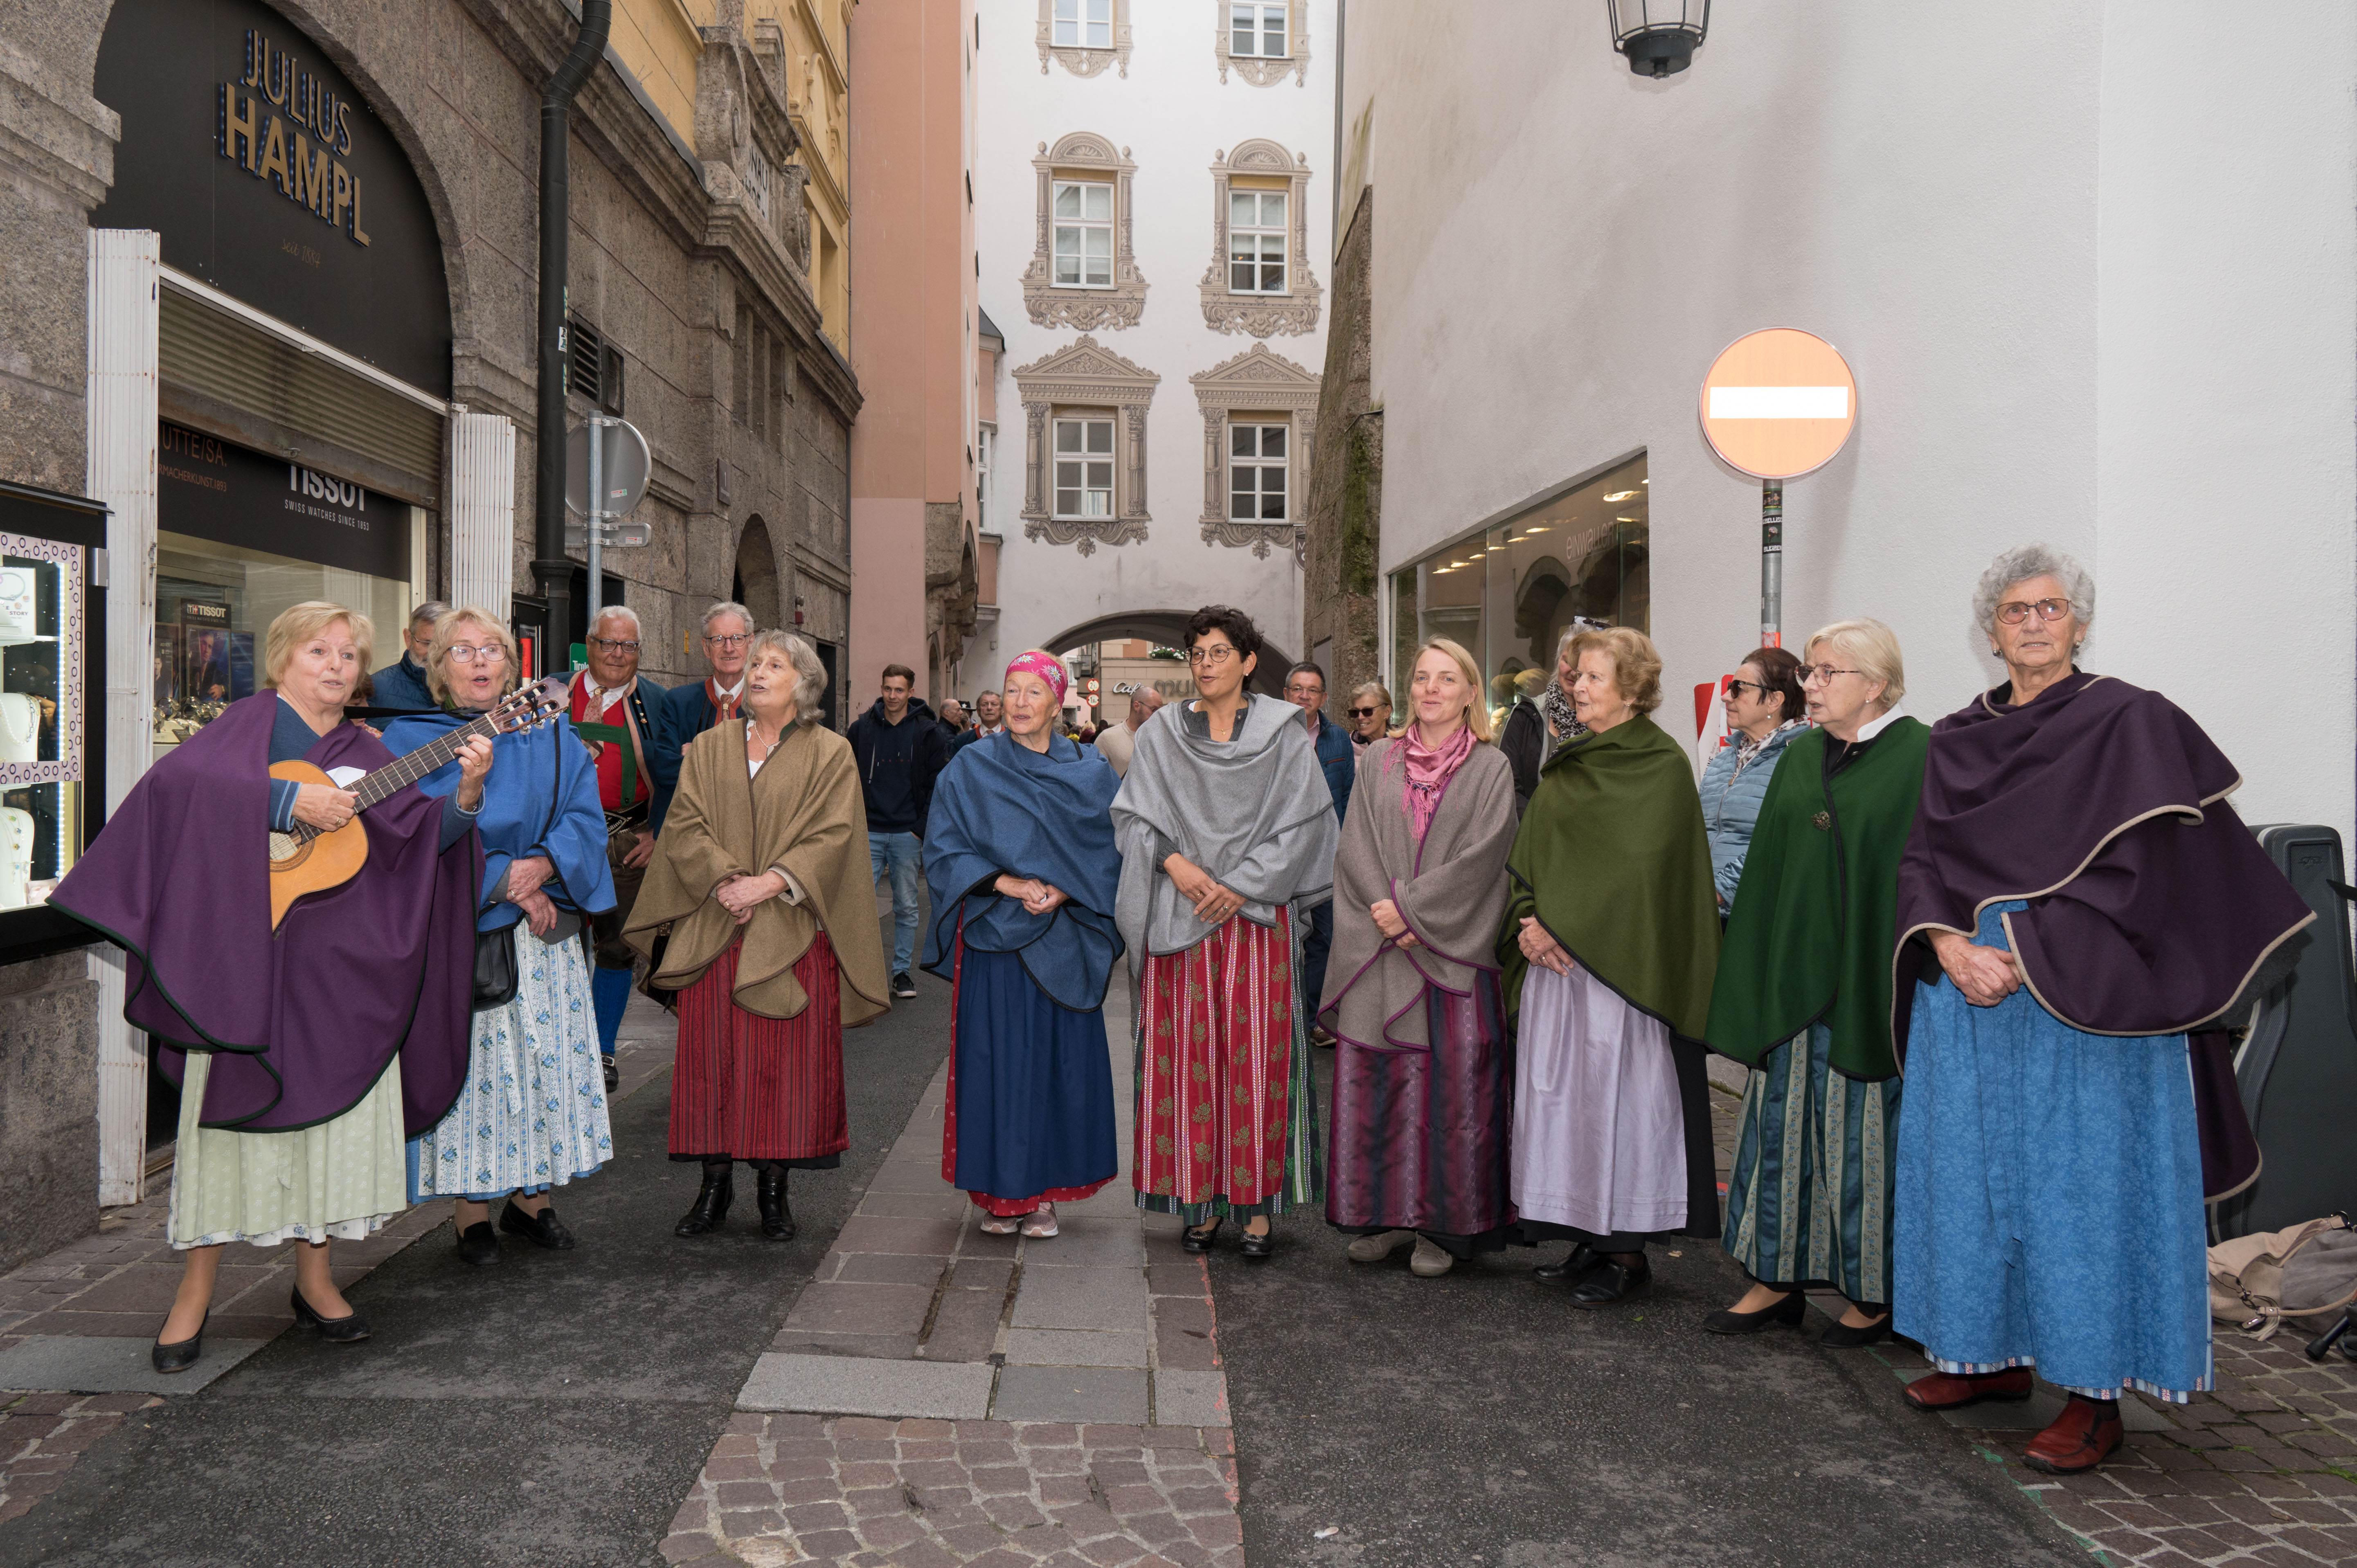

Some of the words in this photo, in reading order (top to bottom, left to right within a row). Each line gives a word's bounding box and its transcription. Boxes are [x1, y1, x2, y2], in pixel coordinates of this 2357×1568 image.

[242, 29, 351, 156] JULIUS
[220, 82, 369, 247] HAMPL
[749, 146, 768, 192] NAU
[282, 238, 299, 256] seit
[158, 425, 227, 467] UTTE/SA.
[285, 499, 305, 513] SWISS
[308, 506, 336, 522] WATCHES
[338, 514, 355, 527] SINCE
[358, 520, 369, 531] 1853
[198, 605, 226, 618] TISSOT
[1112, 681, 1144, 695] Caf
